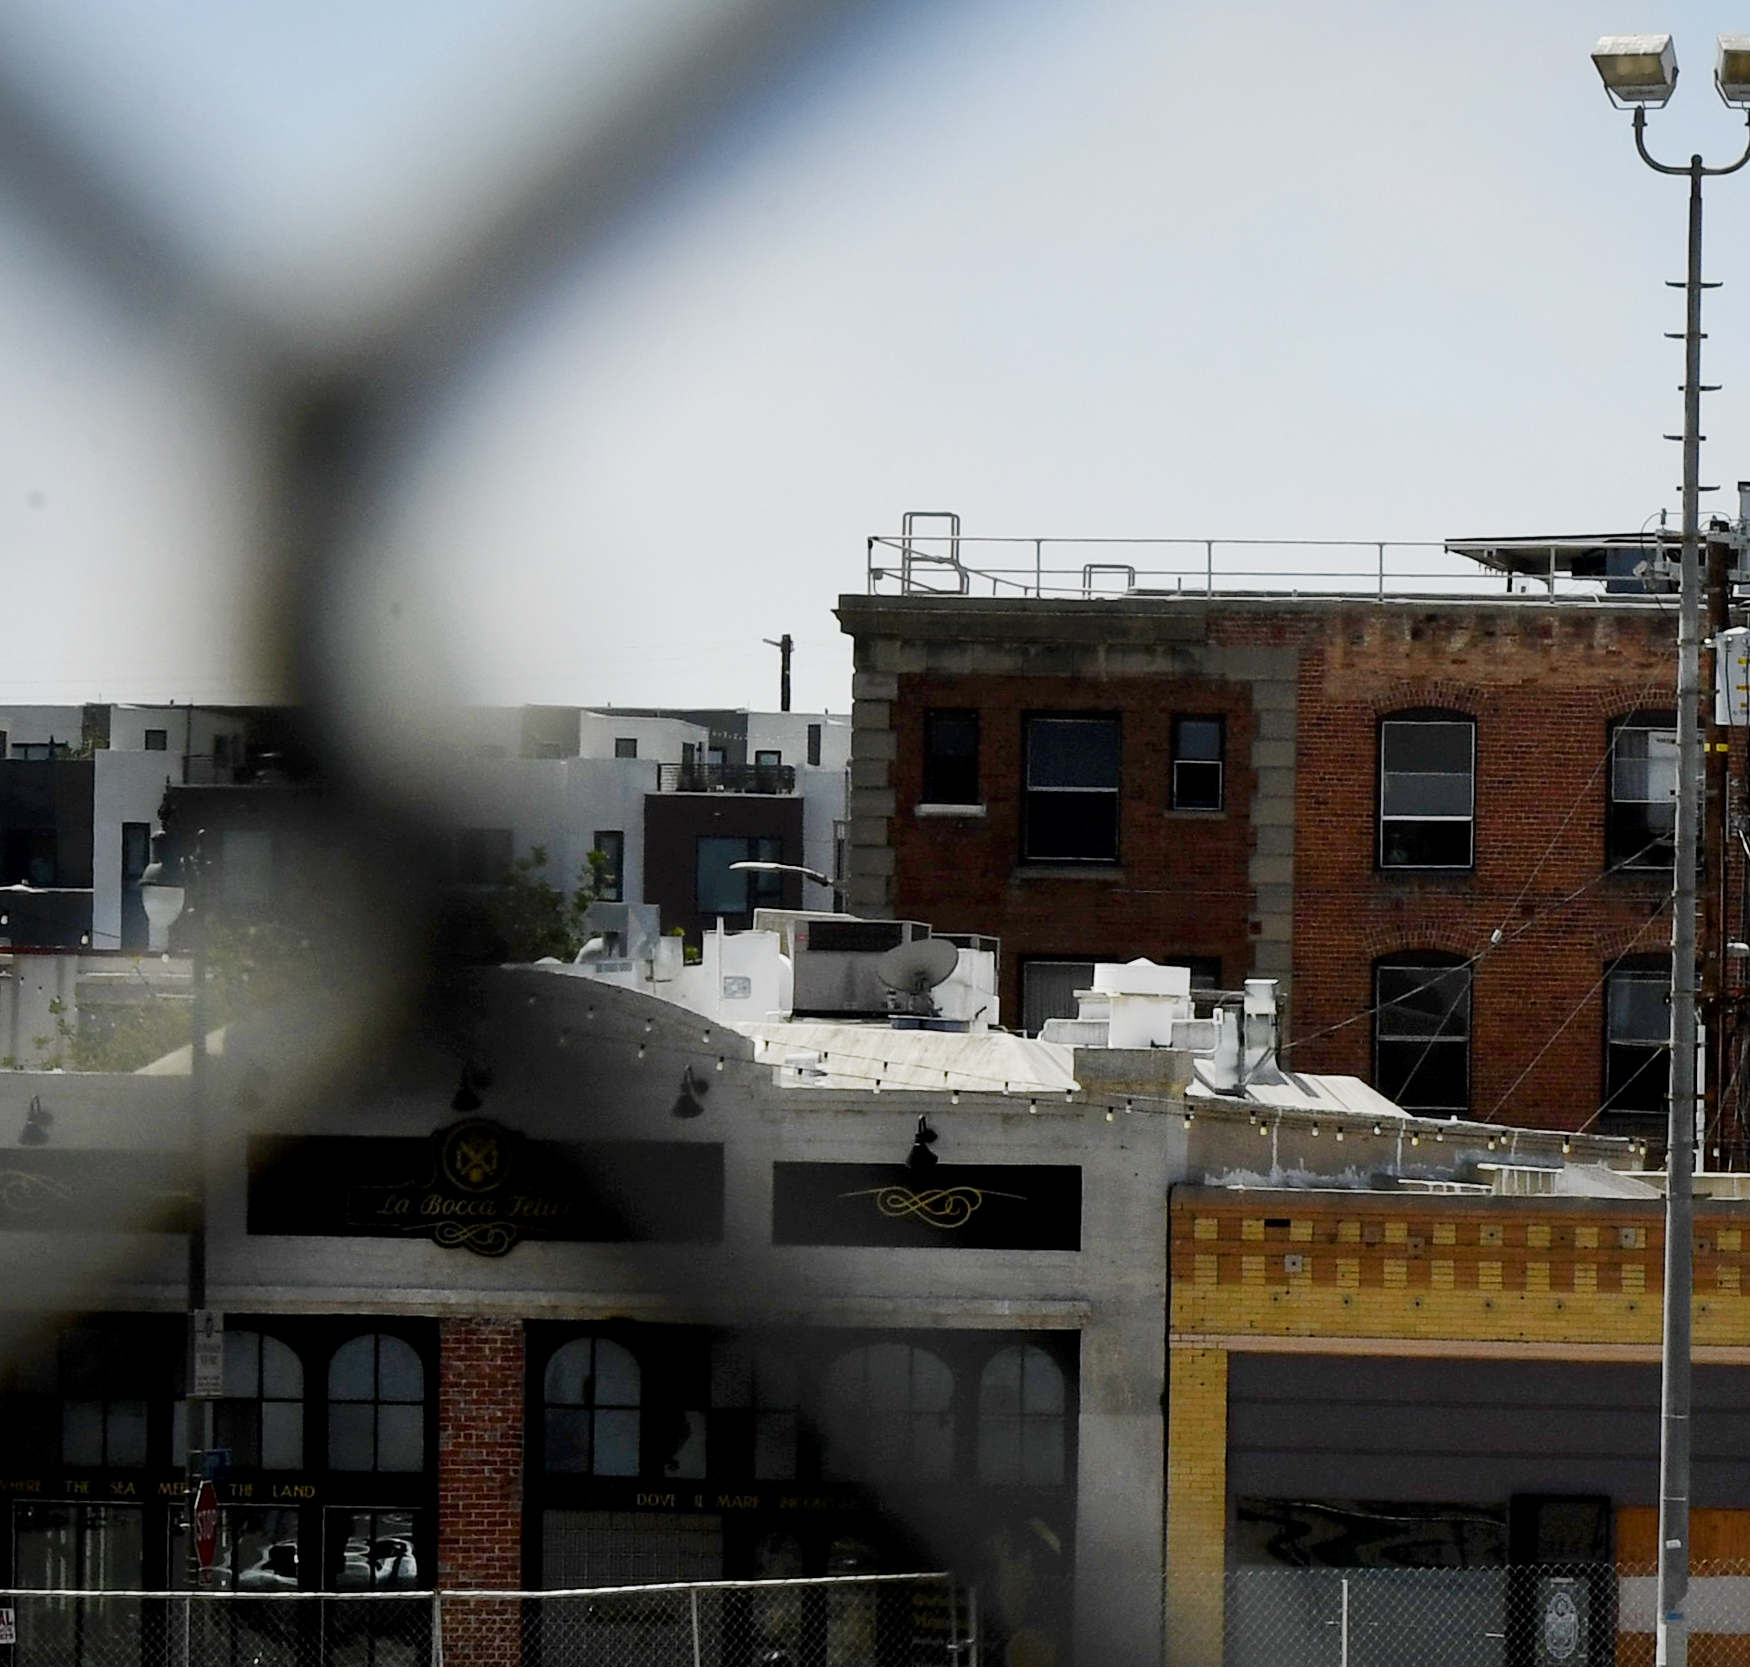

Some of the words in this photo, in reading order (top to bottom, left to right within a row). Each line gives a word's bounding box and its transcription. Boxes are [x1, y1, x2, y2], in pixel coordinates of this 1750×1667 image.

[420, 1193, 497, 1216] Bocca
[110, 1481, 136, 1495] SEA
[272, 1484, 316, 1498] LAND
